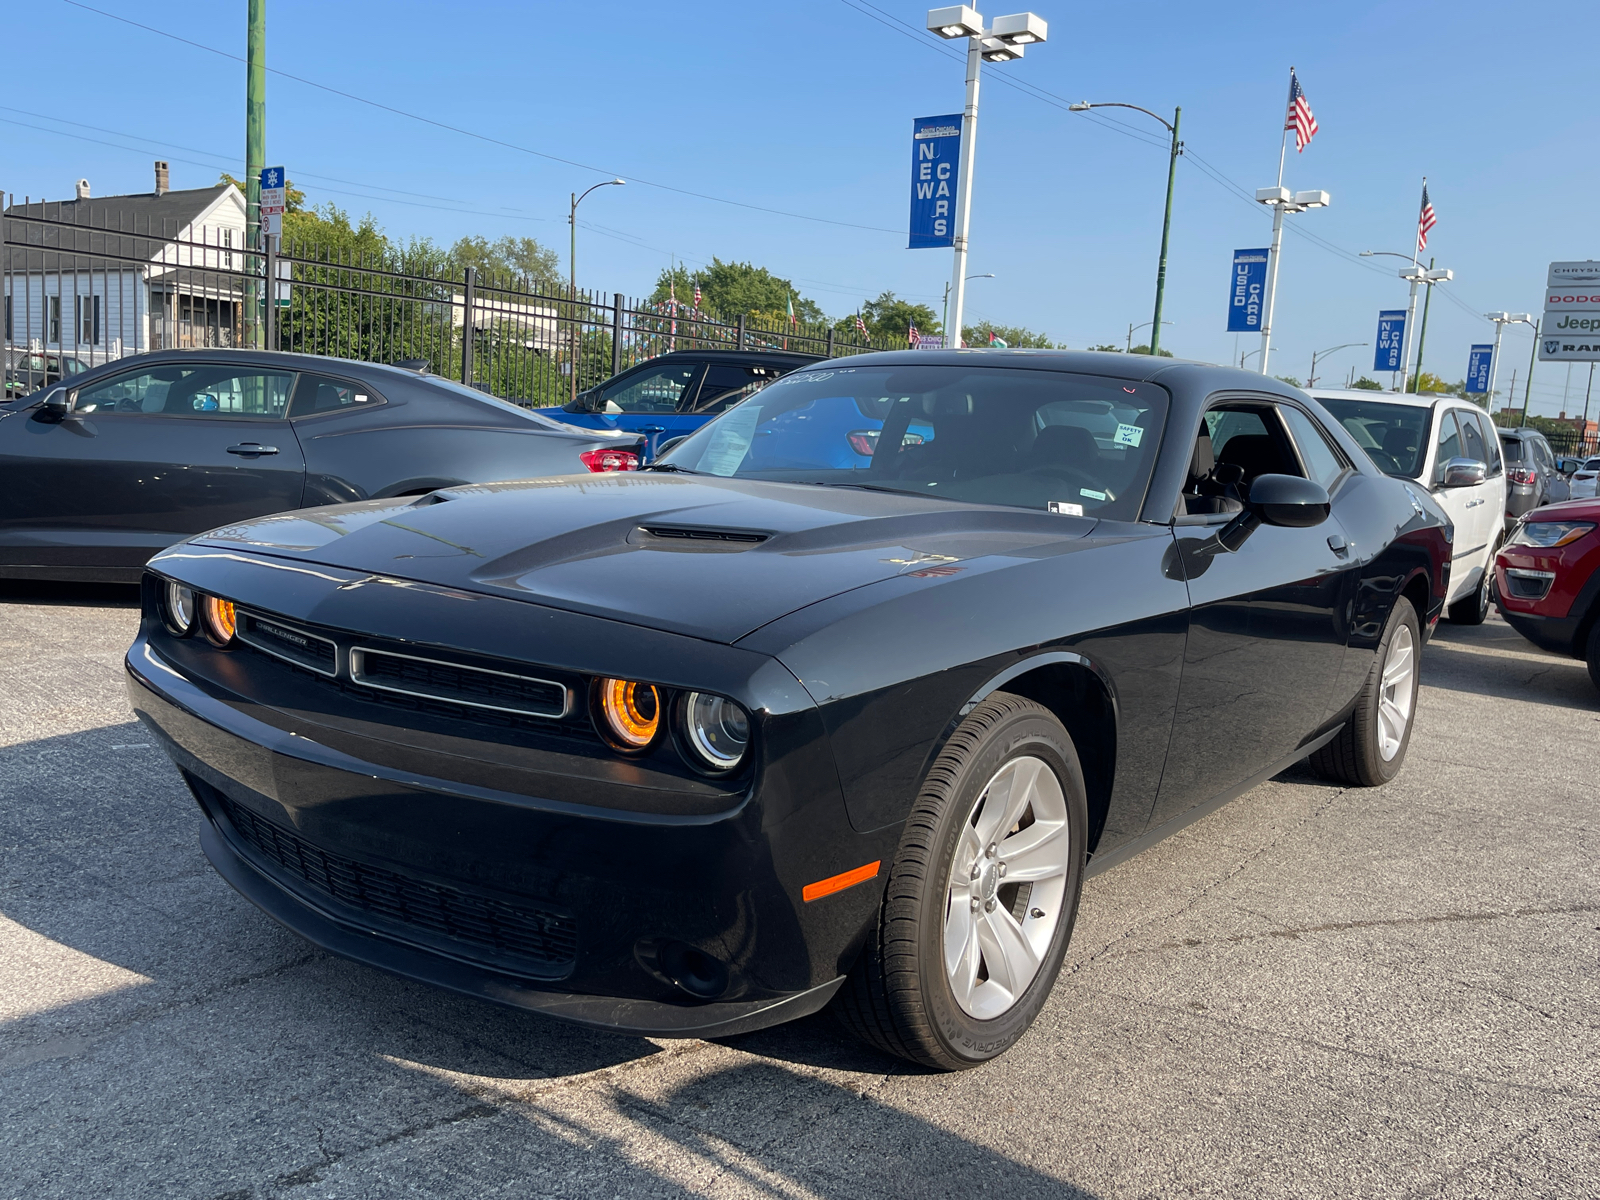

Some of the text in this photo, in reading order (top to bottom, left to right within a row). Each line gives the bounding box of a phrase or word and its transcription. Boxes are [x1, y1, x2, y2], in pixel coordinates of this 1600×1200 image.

[917, 142, 934, 200] NEW
[935, 162, 950, 236] CARS
[1234, 264, 1249, 306] USED
[1246, 283, 1260, 325] CARS
[1380, 322, 1391, 349] NEW
[1557, 315, 1600, 332] Jeep
[1388, 331, 1400, 366] CARS
[1470, 353, 1480, 378] USED
[1477, 364, 1488, 389] CARS
[1119, 425, 1142, 434] SAFETY
[256, 621, 307, 646] CHALLENGER
[944, 820, 959, 861] 100V
